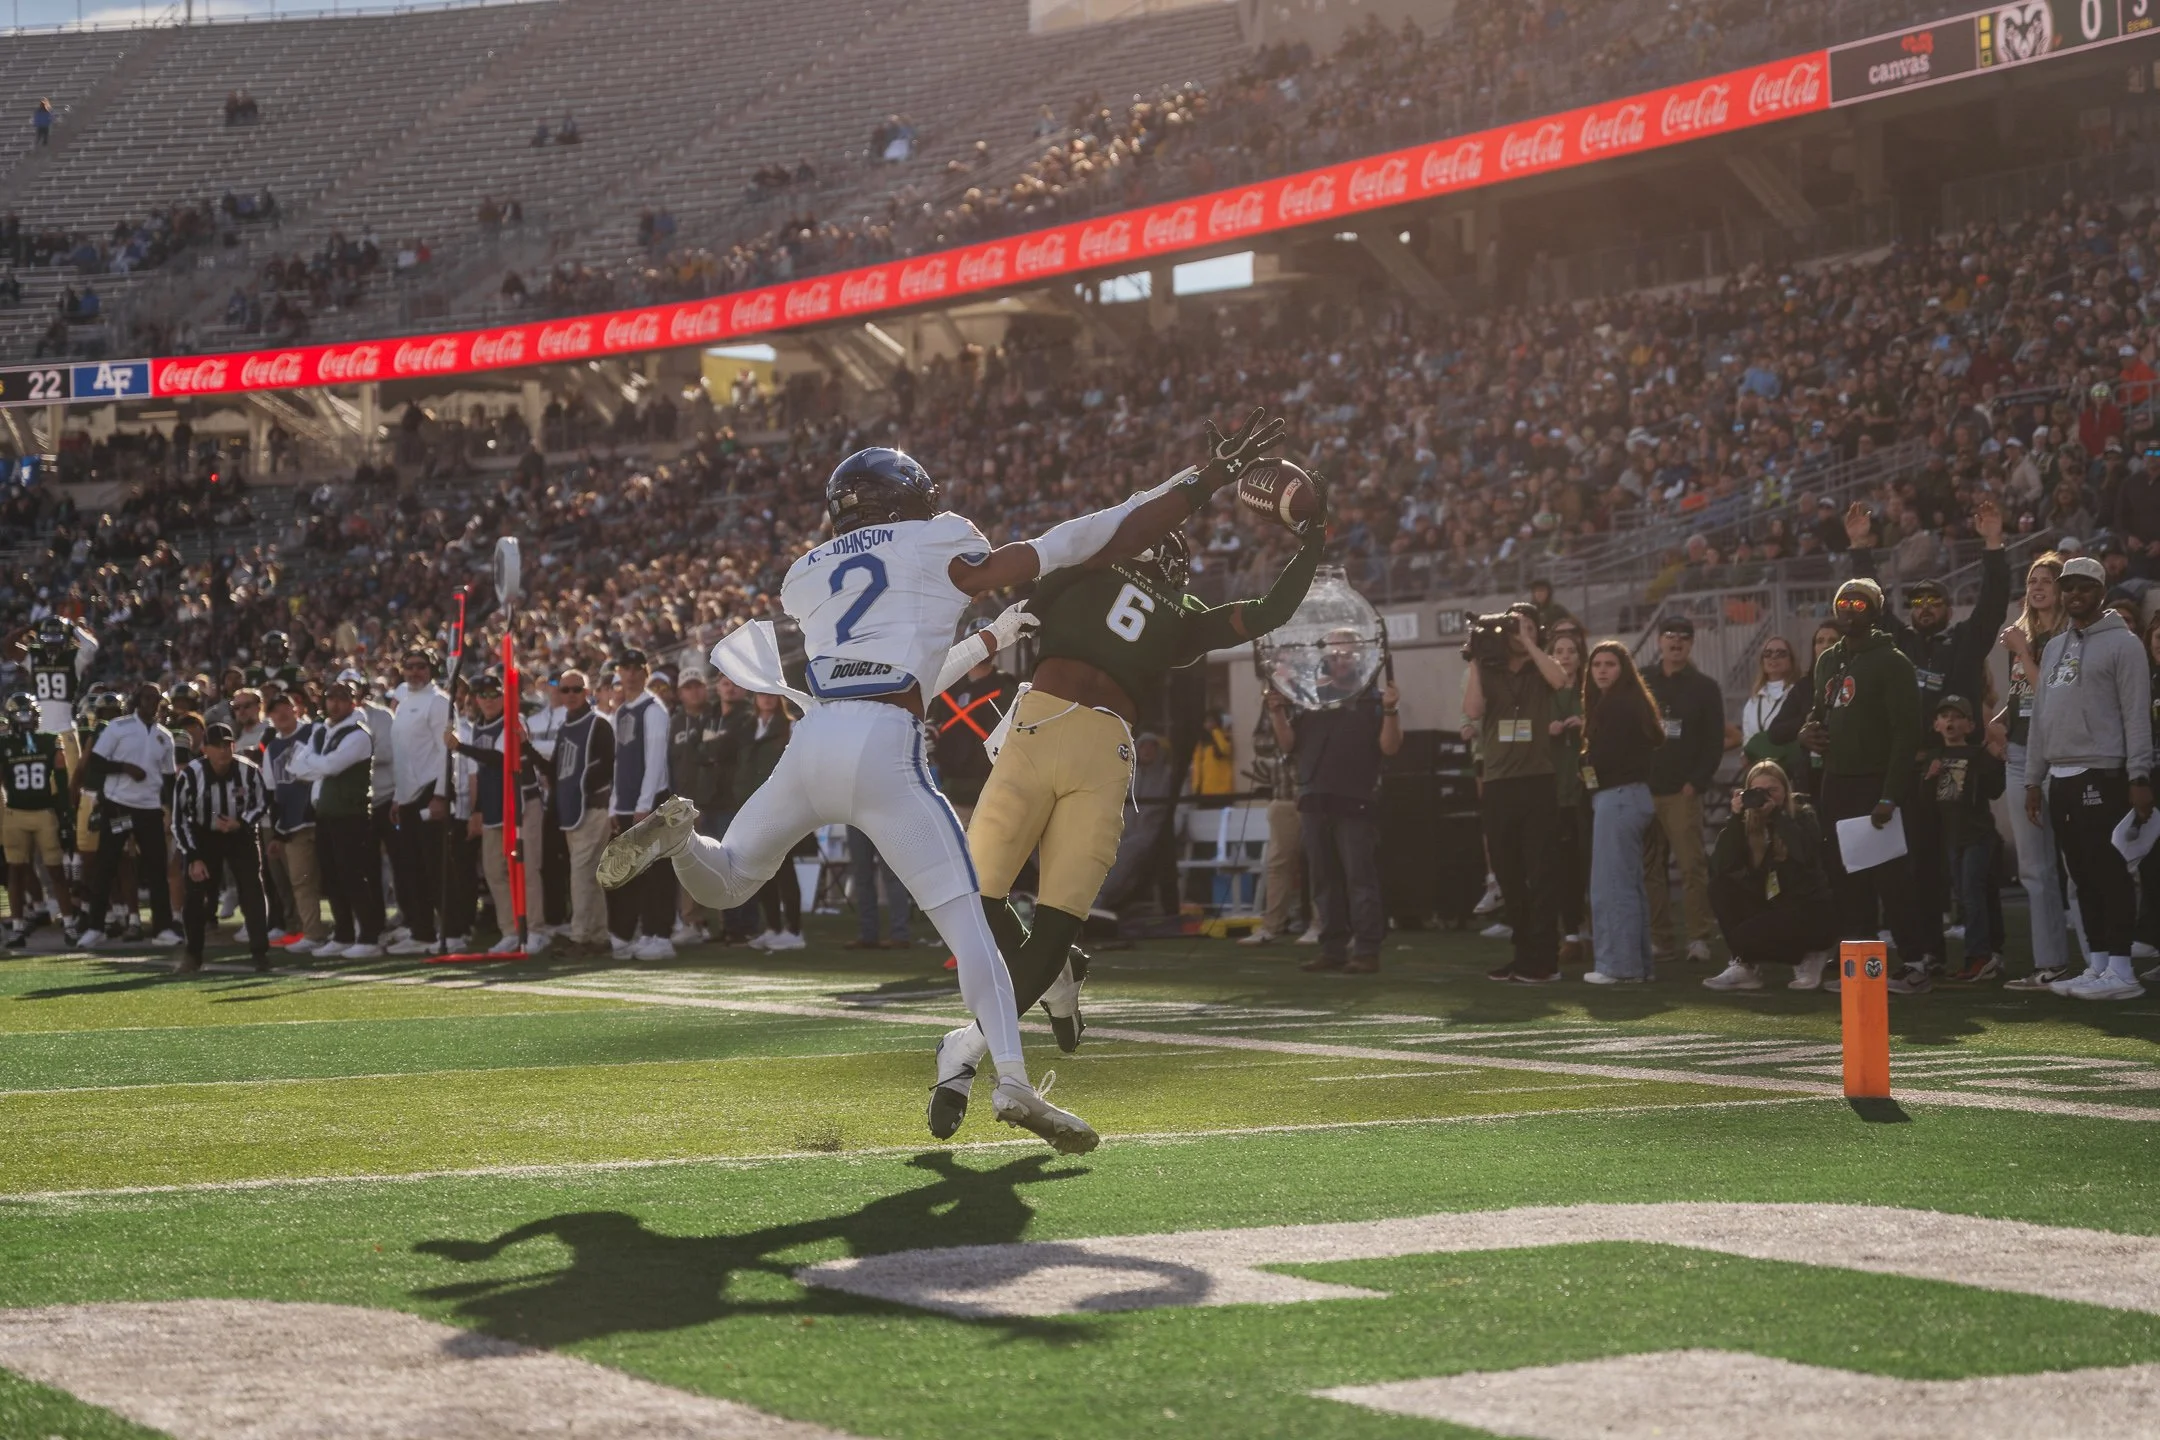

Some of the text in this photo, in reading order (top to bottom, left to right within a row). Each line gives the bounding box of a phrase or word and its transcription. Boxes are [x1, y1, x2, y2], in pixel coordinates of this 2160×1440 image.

[2080, 0, 2102, 40] 0
[1868, 53, 1930, 85] canvas
[28, 370, 62, 399] 22
[92, 362, 133, 399] AF
[825, 528, 895, 556] JOHNSON
[828, 552, 890, 647] 2
[1105, 582, 1156, 642] 6
[1155, 592, 1187, 618] STATE
[35, 672, 67, 699] 89
[829, 661, 893, 681] DOUGLAS
[13, 762, 46, 790] 88
